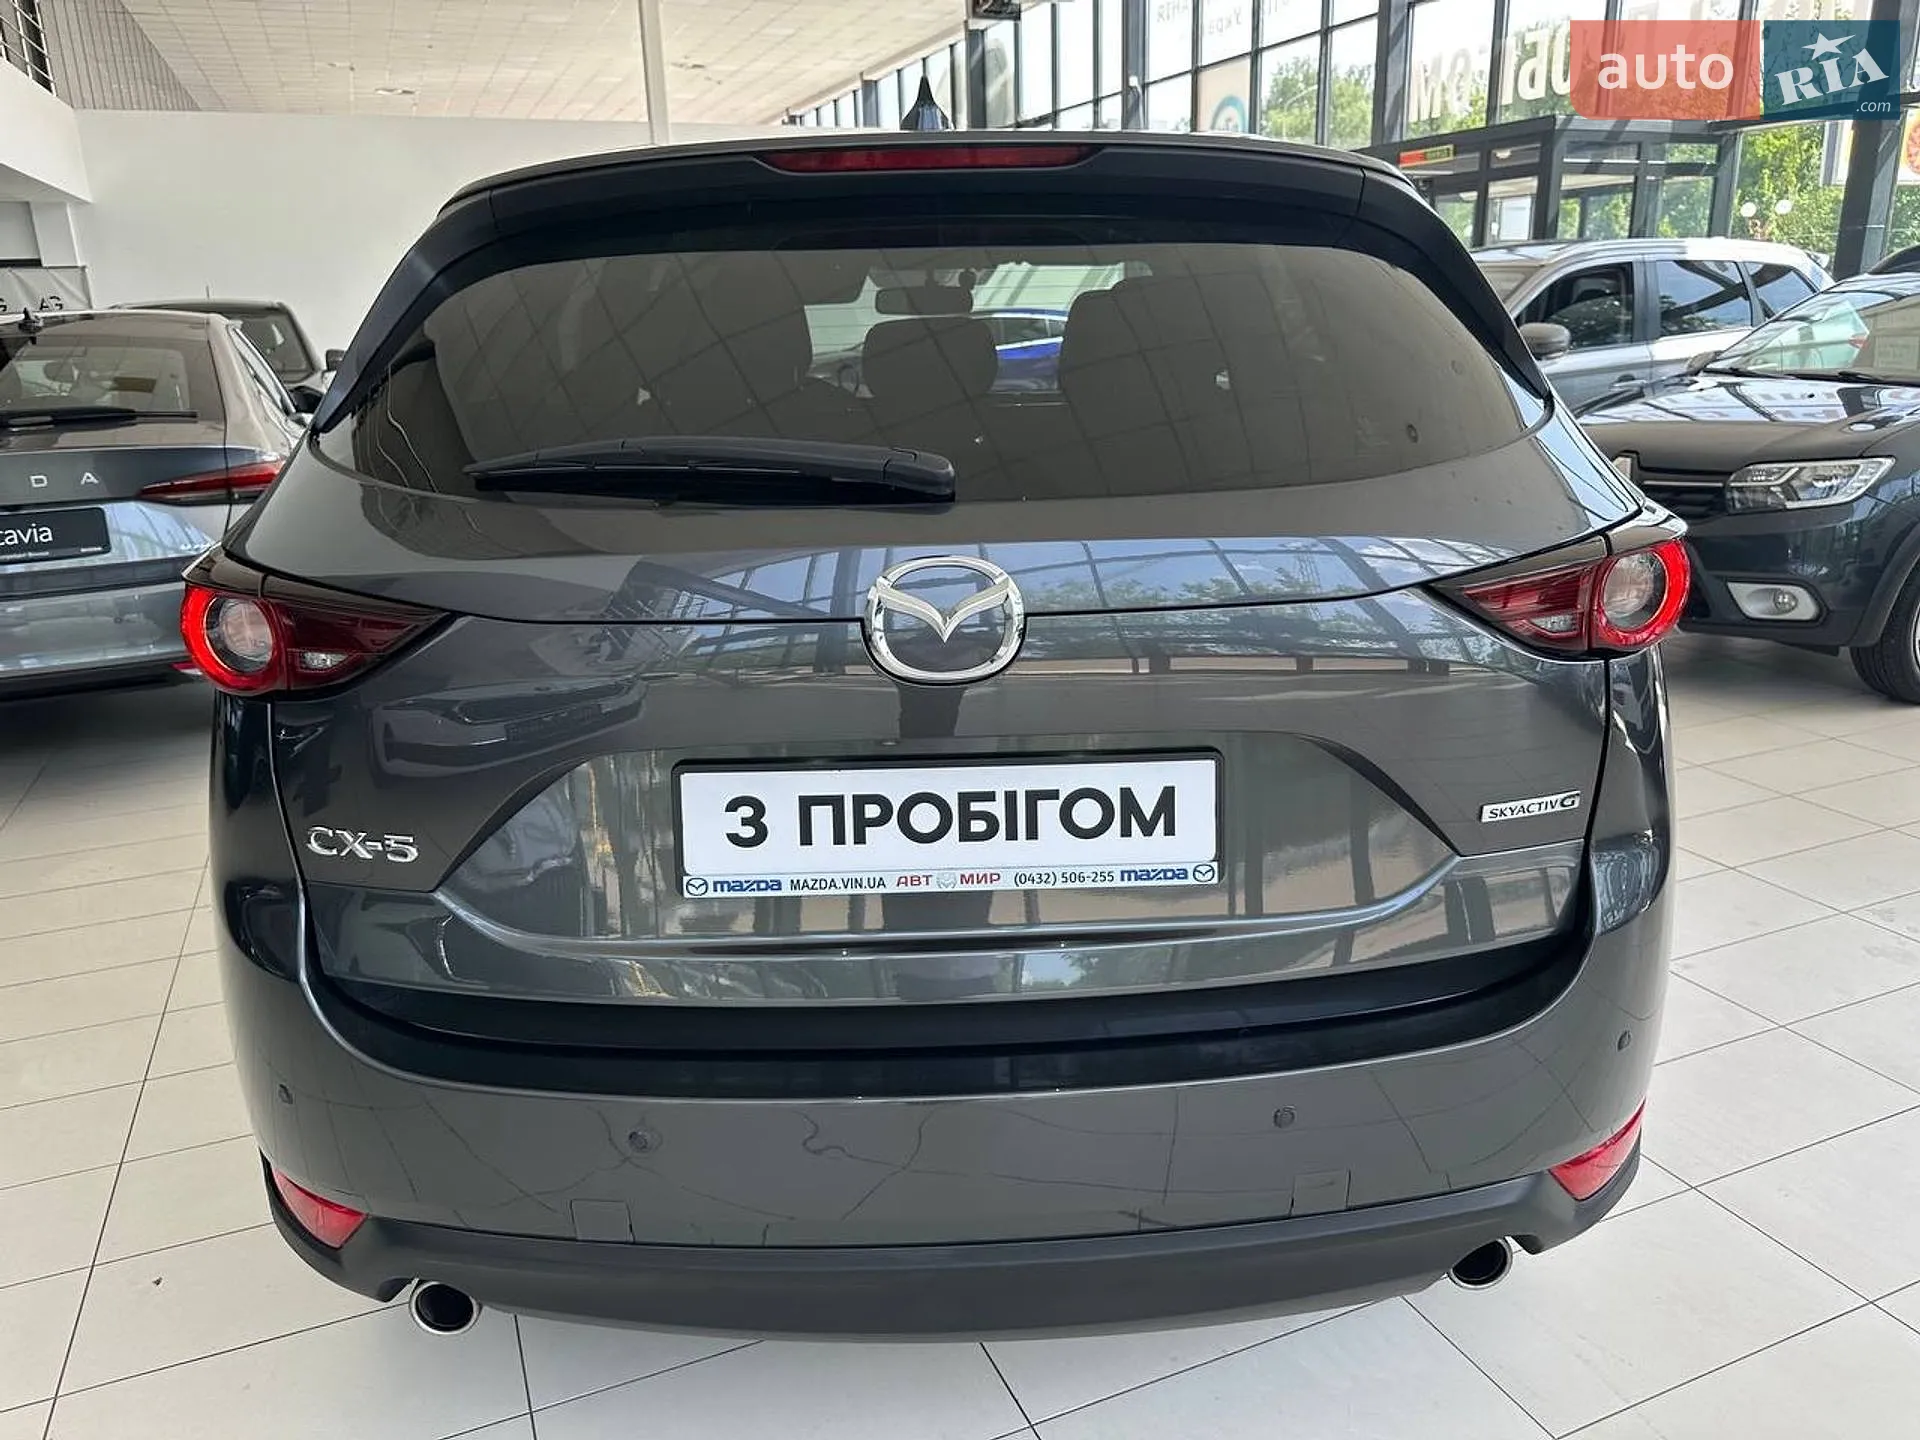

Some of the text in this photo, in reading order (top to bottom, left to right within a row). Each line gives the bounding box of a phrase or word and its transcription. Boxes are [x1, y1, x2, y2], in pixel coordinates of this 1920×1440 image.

[725, 786, 1176, 848] З ПРОБІГОМ
[306, 825, 419, 863] CX-5
[790, 876, 886, 891] MAZDA.VIN.UA
[1013, 871, 1057, 886] (0432)
[1061, 869, 1114, 884] 506-255
